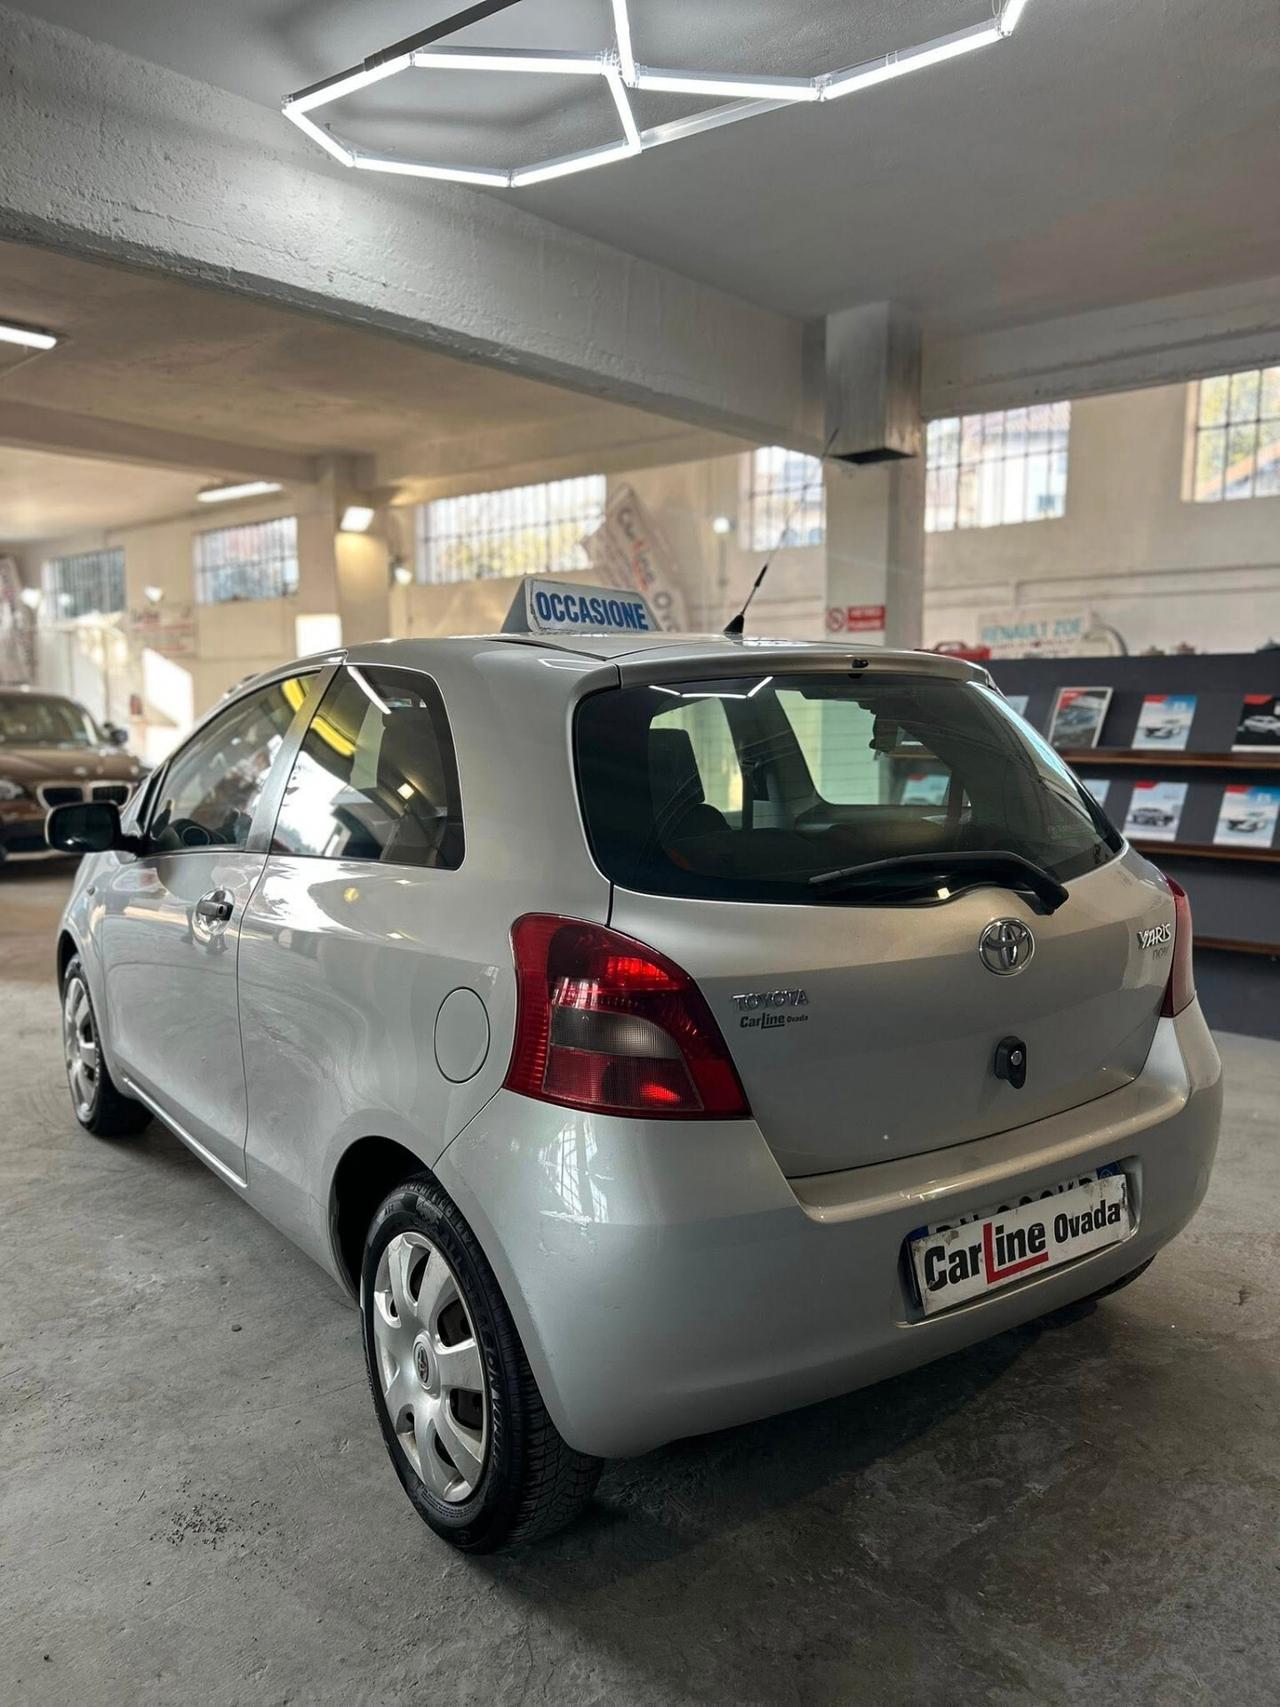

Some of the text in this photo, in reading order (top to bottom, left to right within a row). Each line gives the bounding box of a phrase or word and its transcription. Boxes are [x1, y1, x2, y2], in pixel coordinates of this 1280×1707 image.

[535, 591, 648, 630] OCCASIONE
[1137, 923, 1172, 949] YARIS
[732, 989, 808, 1011] TOYOTA
[740, 1012, 785, 1030] CarLine
[924, 1221, 1049, 1292] CarLine
[1053, 1199, 1121, 1243] Ovada
